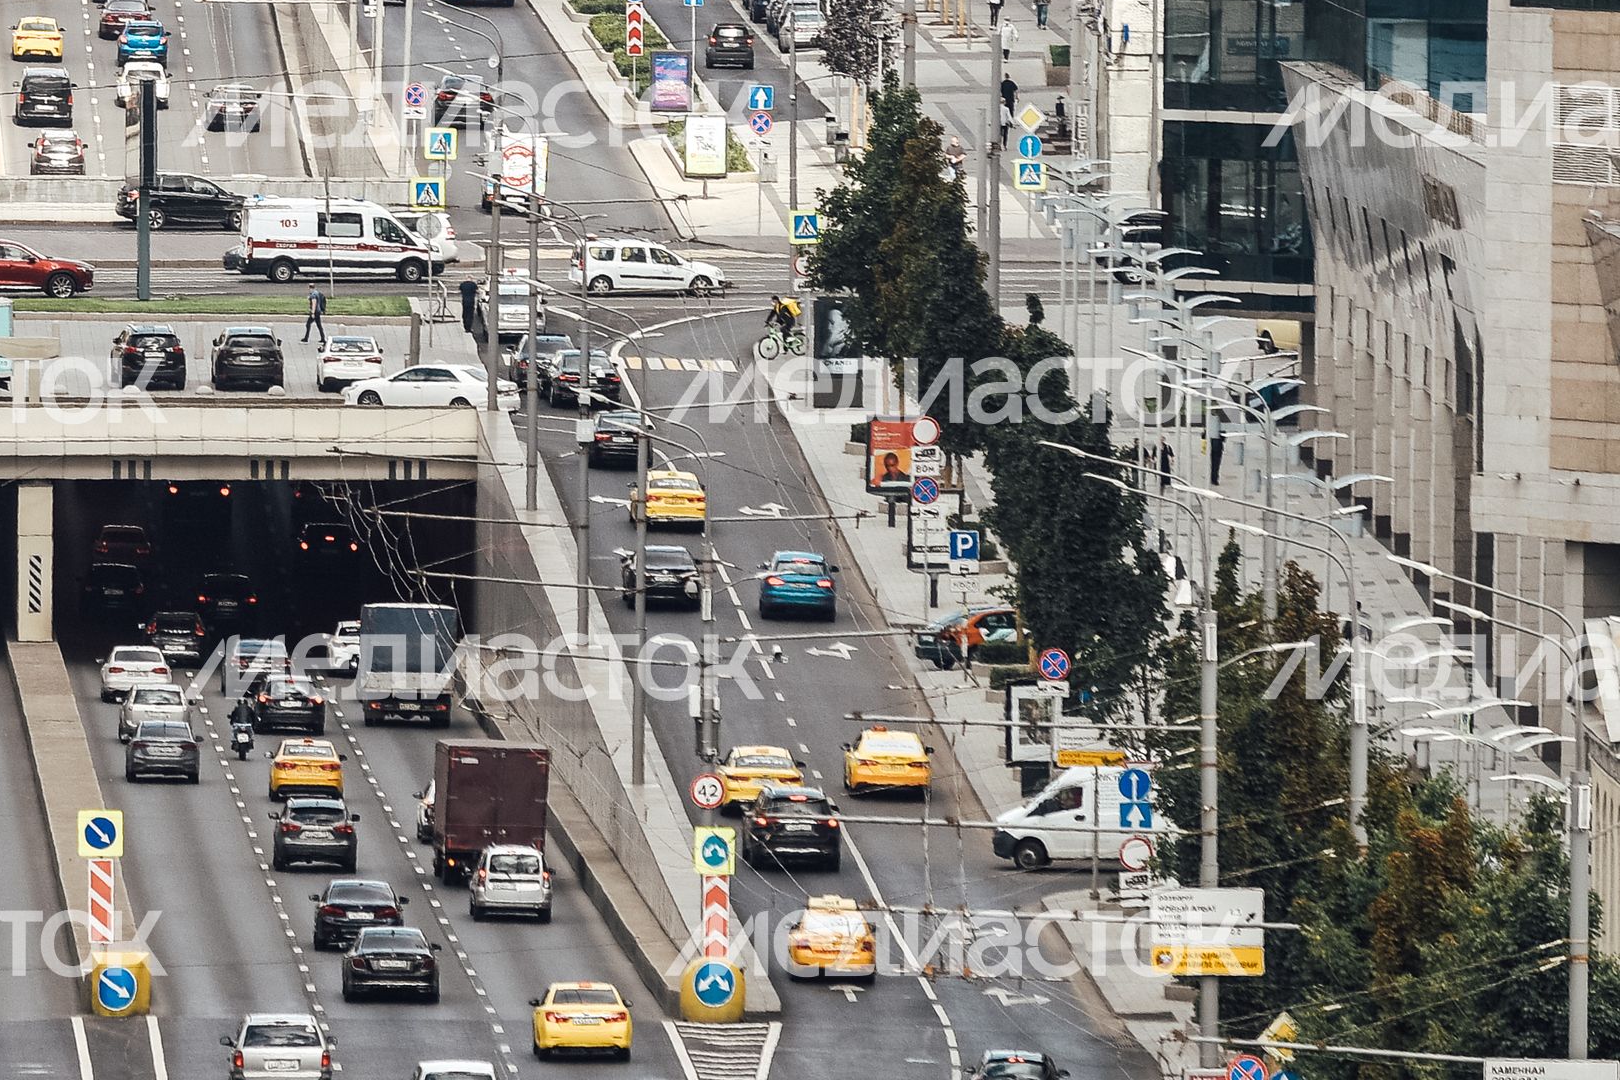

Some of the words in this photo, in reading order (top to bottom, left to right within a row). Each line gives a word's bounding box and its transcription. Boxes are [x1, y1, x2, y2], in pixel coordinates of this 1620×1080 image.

[280, 219, 299, 228] 103
[956, 534, 974, 557] P
[1491, 1065, 1546, 1074] КАМЕННАЯ
